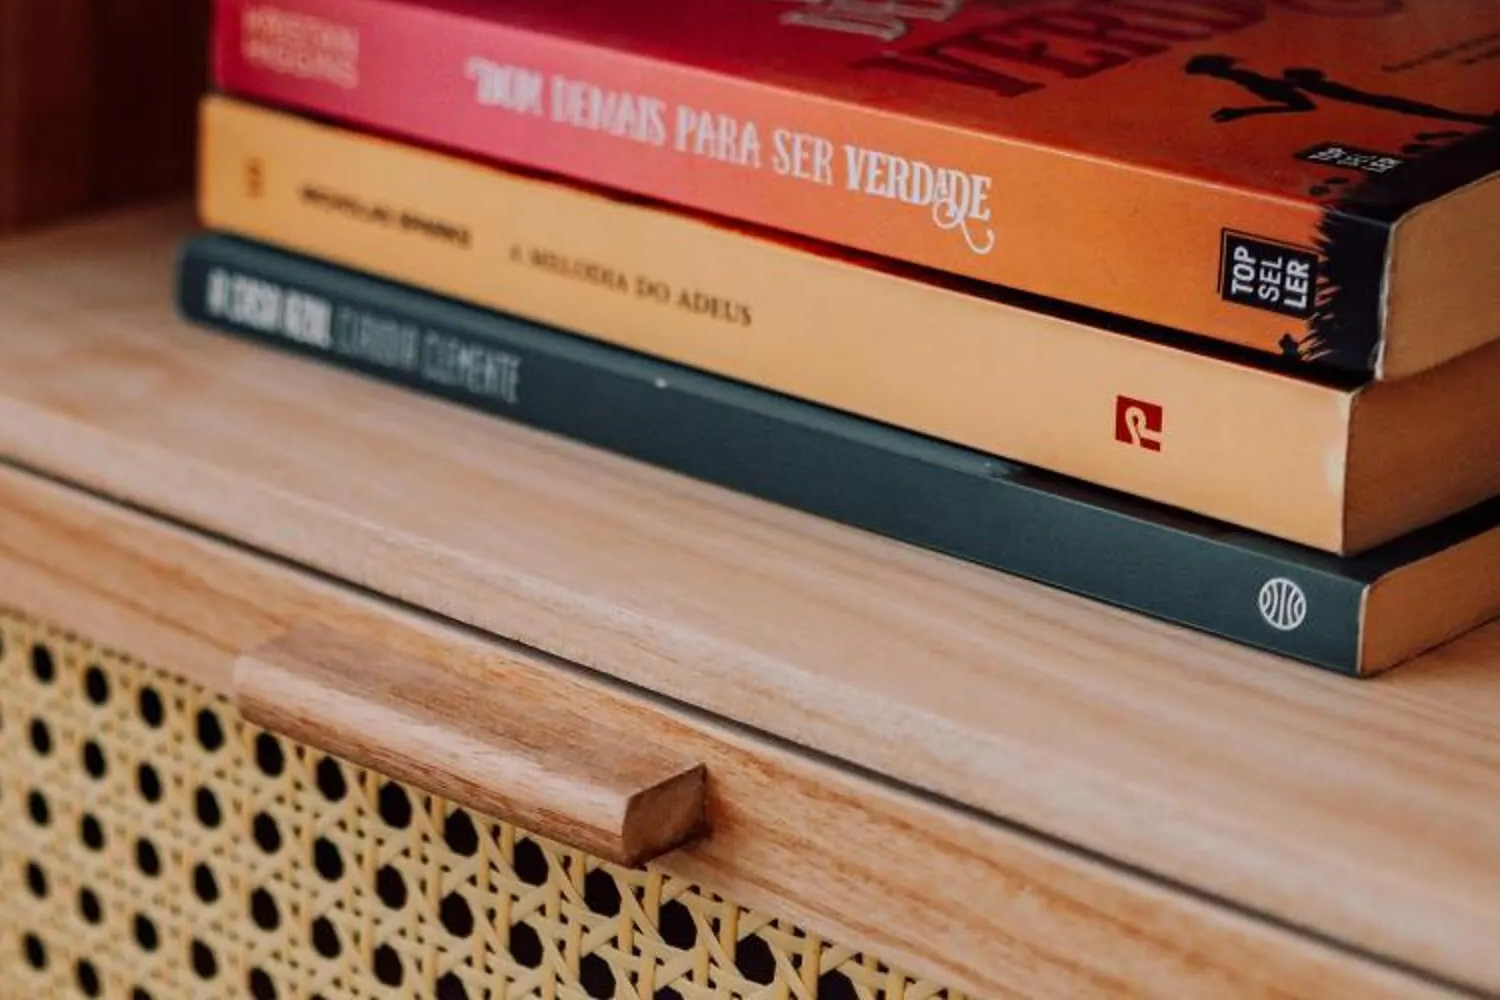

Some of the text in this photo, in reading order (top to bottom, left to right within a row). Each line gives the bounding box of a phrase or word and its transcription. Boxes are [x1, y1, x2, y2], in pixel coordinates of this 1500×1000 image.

[463, 55, 995, 255] BOM DEMAIS PARA SER VERDADE
[1231, 245, 1257, 295] TOP
[1257, 256, 1283, 302] SEL
[1283, 258, 1310, 309] LER
[633, 273, 671, 305] DO
[676, 288, 752, 328] ADEUS
